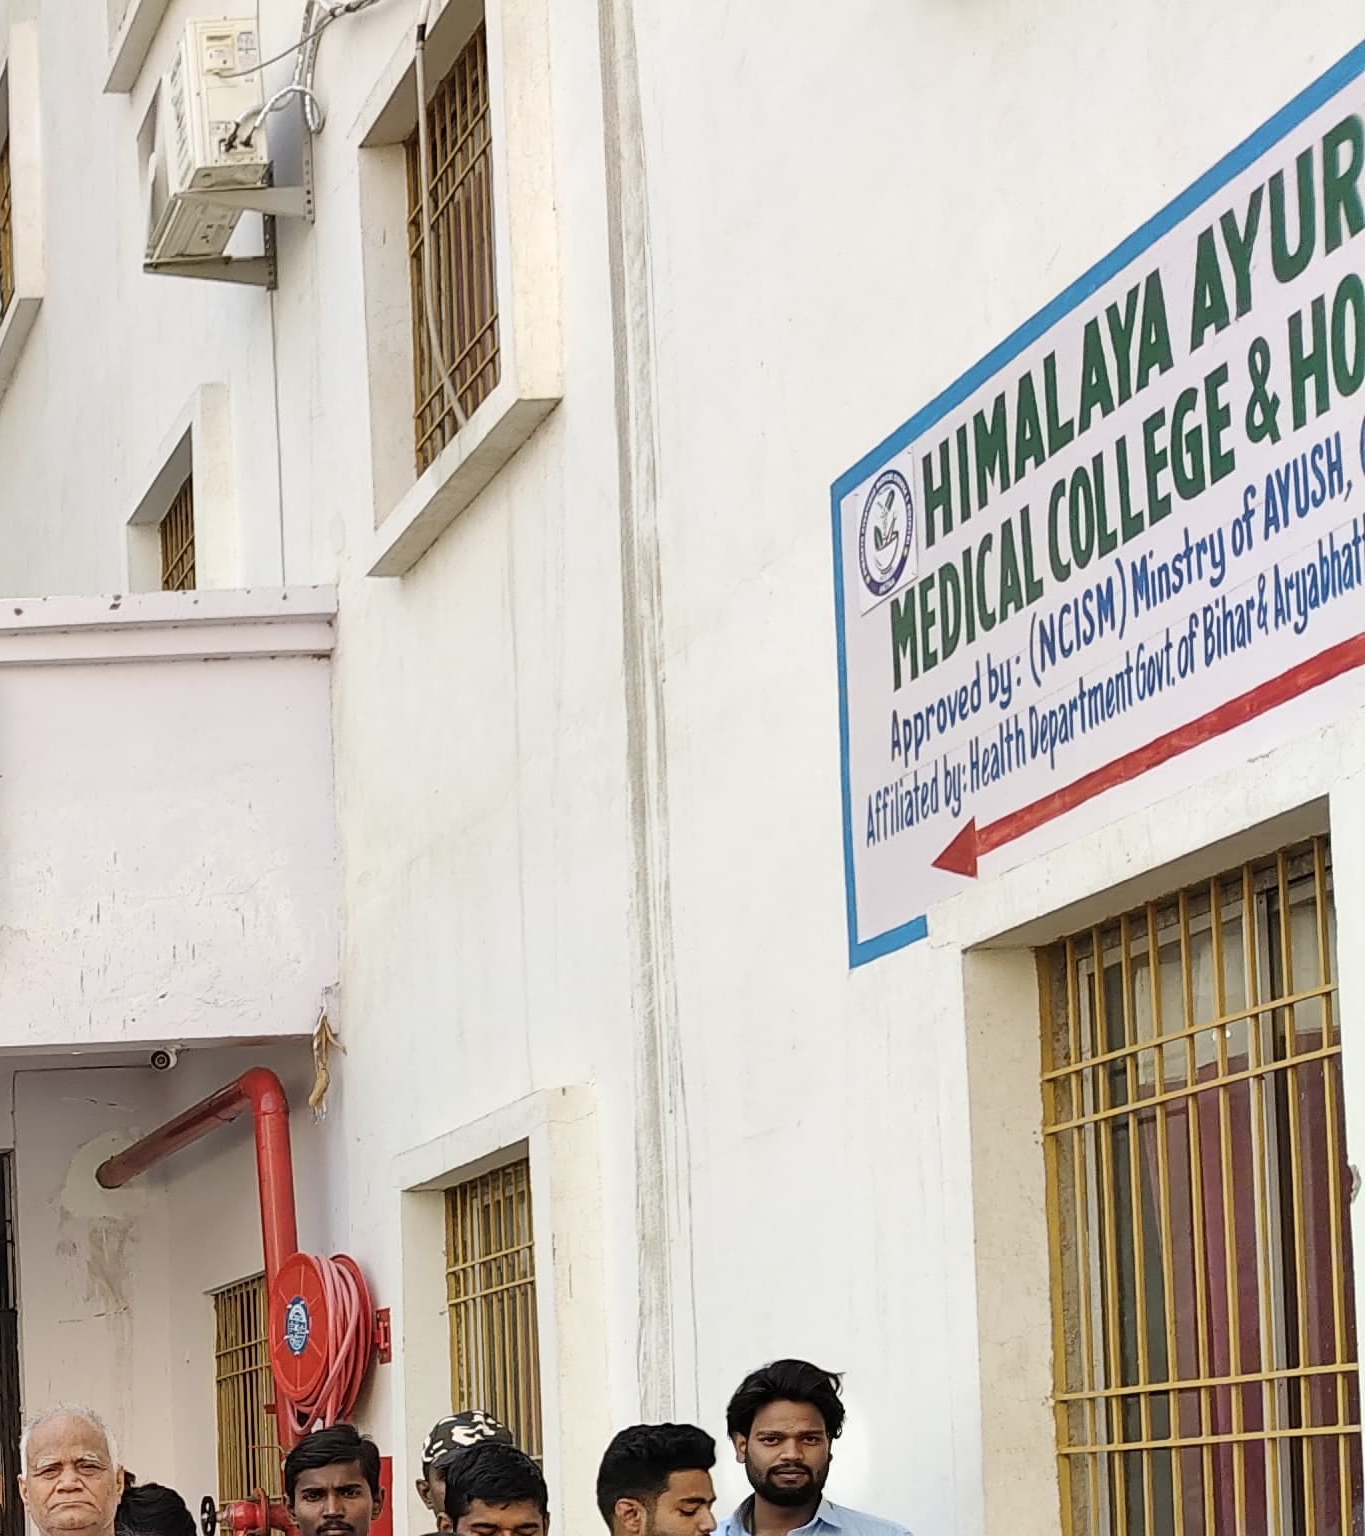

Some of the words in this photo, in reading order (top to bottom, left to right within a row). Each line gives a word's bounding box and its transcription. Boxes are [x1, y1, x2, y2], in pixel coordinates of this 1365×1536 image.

[889, 504, 1043, 693] MEDICAL
[1047, 362, 1236, 583] COLLEGE
[1245, 336, 1281, 446] &
[1287, 273, 1365, 432] HO
[921, 267, 1174, 551] HIMALAYA
[1189, 113, 1365, 355] AYUR
[866, 758, 939, 849] Affiliated
[943, 753, 968, 818] by:
[969, 713, 1027, 794] Health
[1028, 650, 1133, 771] Department
[1135, 627, 1176, 702] Govt.
[1177, 611, 1200, 680] of
[1202, 594, 1255, 668] Bihar
[891, 659, 982, 768] Approved
[986, 652, 1022, 710] by:
[1029, 557, 1127, 688] (NCISM)
[1131, 526, 1227, 619] Minstry
[1231, 483, 1256, 557] of
[1263, 430, 1353, 542] AYUSH,
